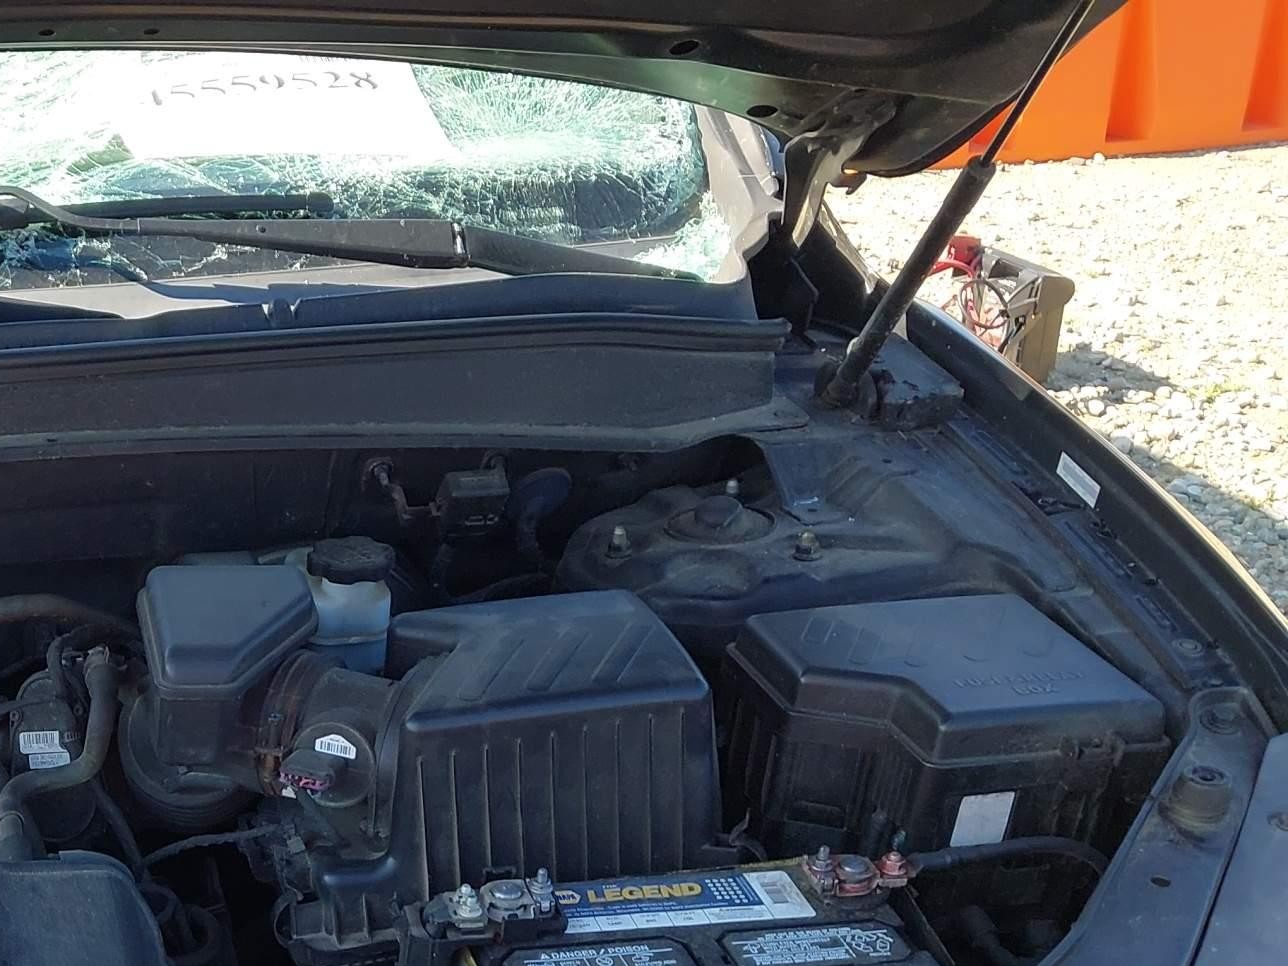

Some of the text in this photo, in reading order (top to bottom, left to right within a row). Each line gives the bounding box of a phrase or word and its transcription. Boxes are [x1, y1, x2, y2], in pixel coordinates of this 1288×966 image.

[586, 882, 702, 904] LEGEND
[551, 949, 596, 960] DANGER
[608, 944, 649, 955] POISON
